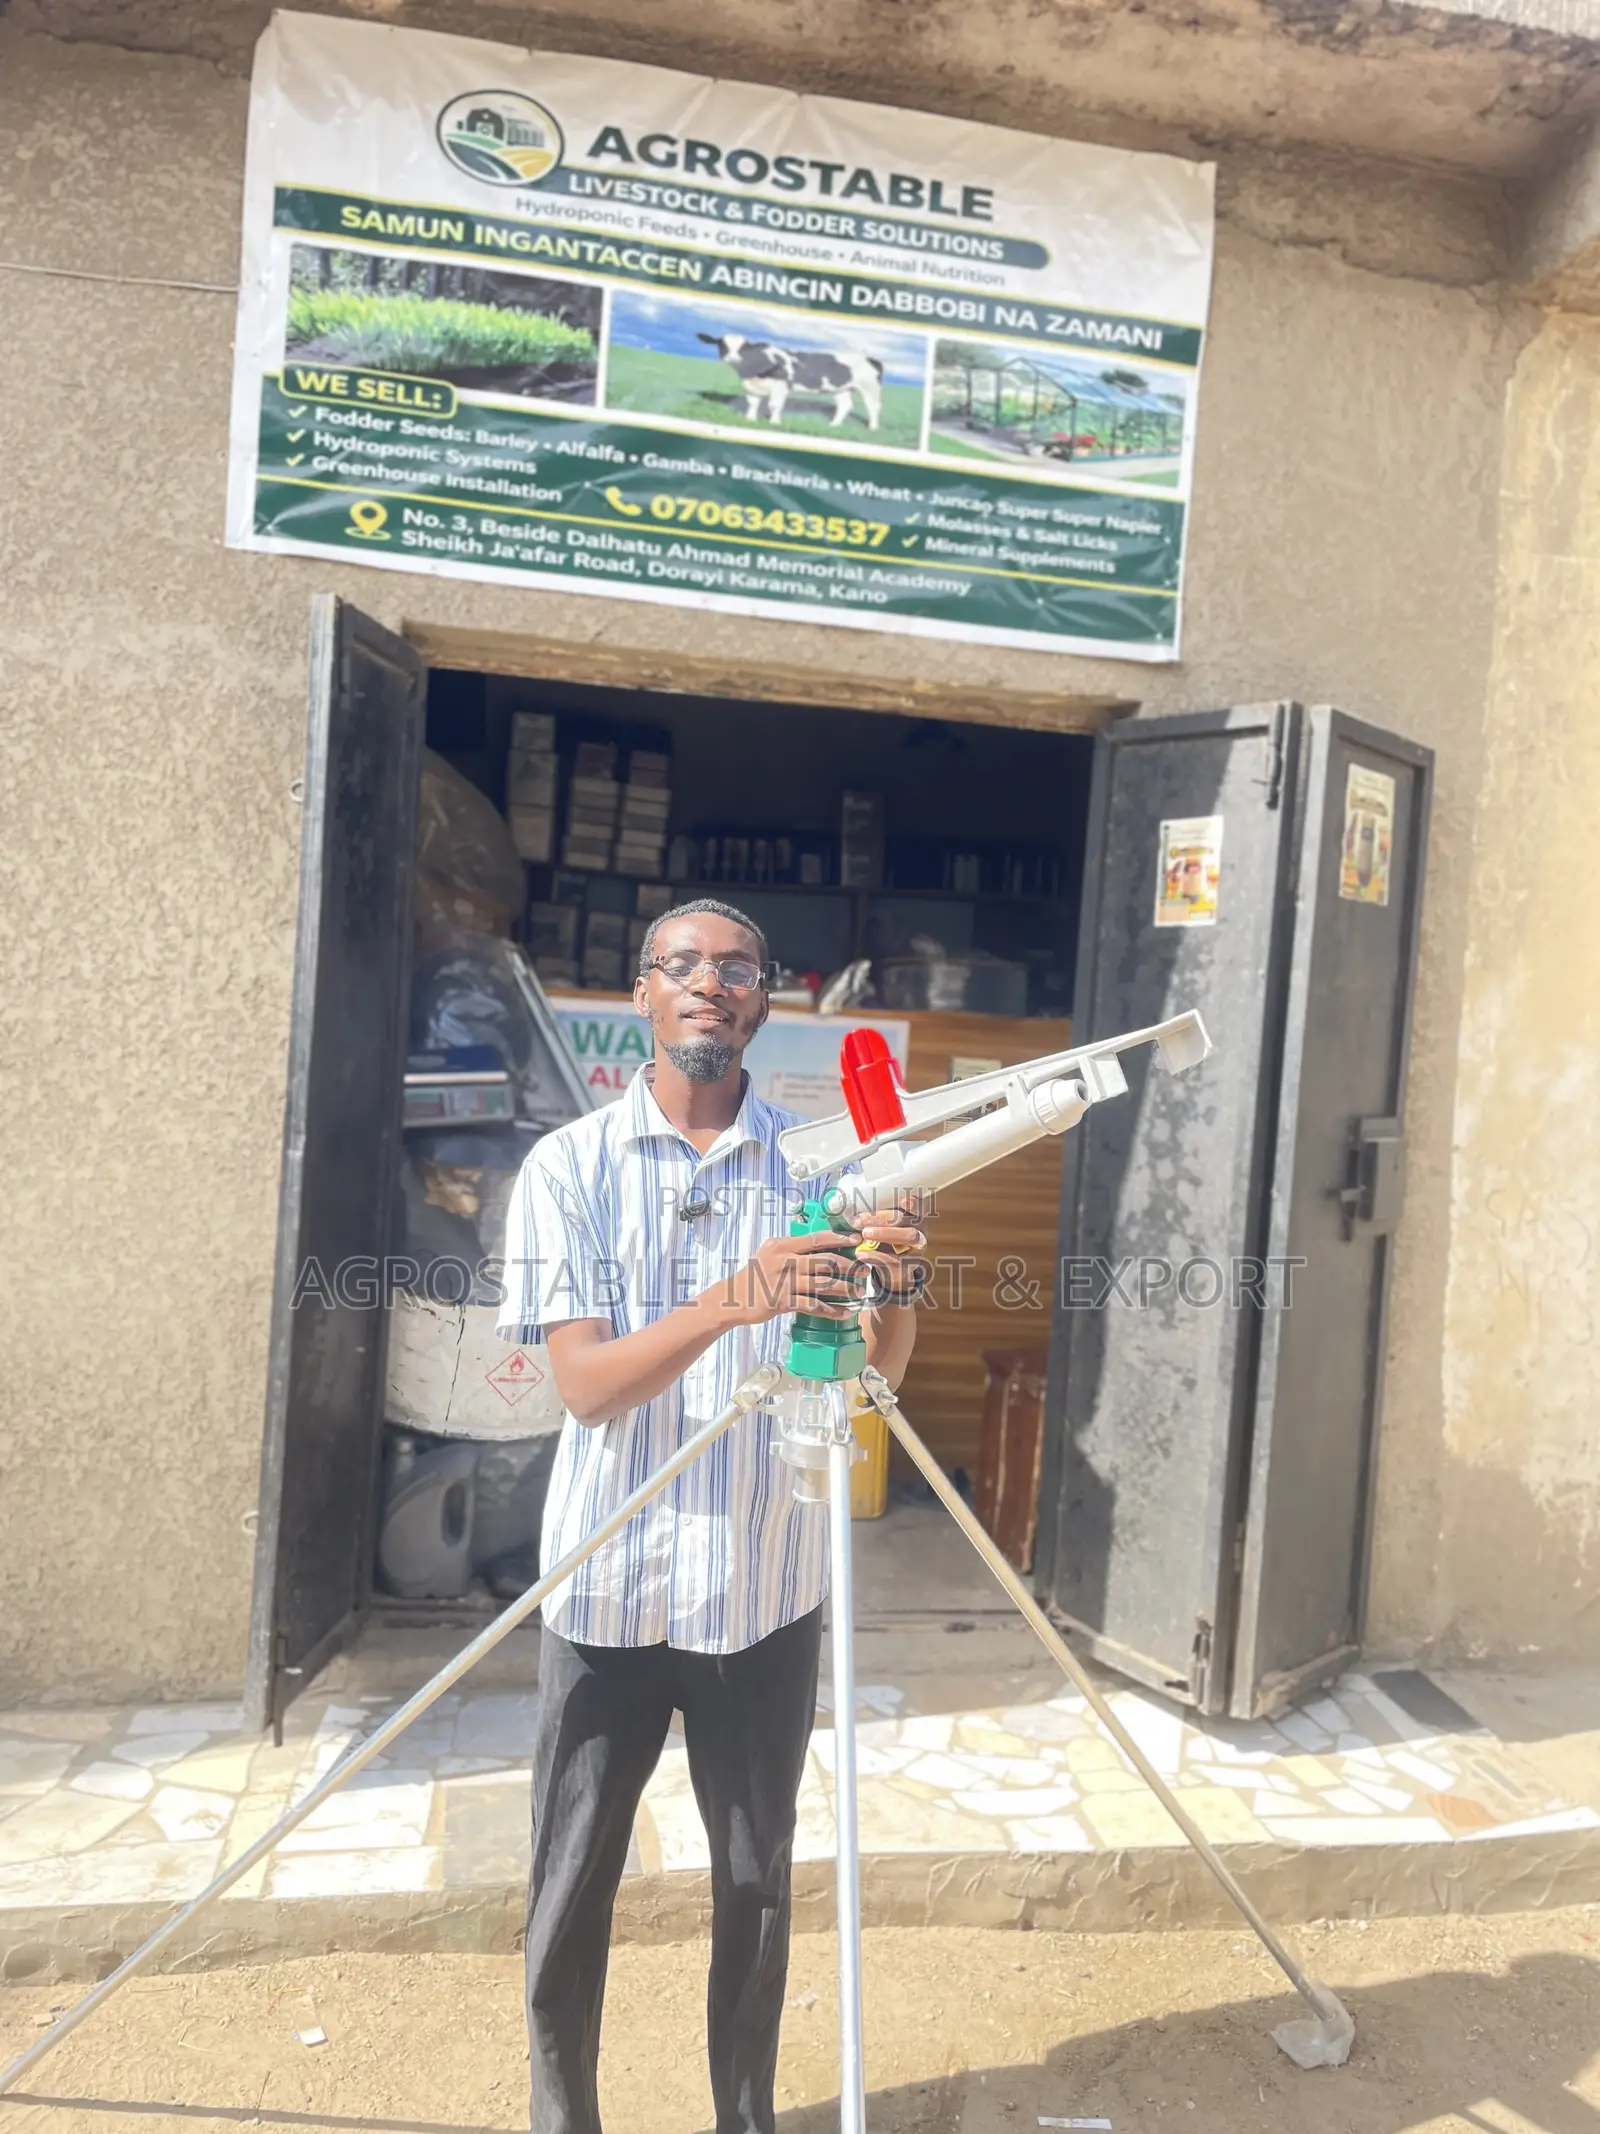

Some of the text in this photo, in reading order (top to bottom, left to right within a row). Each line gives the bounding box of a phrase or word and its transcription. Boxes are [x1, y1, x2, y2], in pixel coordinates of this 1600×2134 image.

[587, 125, 994, 221] AGROSTABLE
[515, 197, 1005, 286] Hydroponic Feeds Greenhouse Animal Nutrition
[569, 174, 1004, 260] LIVESTOCK & FODDER SOLUTIONS
[340, 205, 1163, 351] SAMUN INGANTACCEN ABINCIN DABBOBI NA ZAMANI
[295, 369, 442, 410] WE SELL:
[312, 455, 563, 503] Greenhouse Installation
[313, 431, 537, 475] Hydroponic Systems
[314, 406, 394, 432] Fodder
[400, 419, 472, 443] Seeds:
[475, 428, 538, 454] Barley
[556, 440, 626, 464] Alfalfa
[643, 452, 714, 476] Gamba
[731, 464, 830, 491] Brachiaria
[847, 479, 911, 502] Wheat
[997, 501, 1048, 522] Super
[1052, 508, 1103, 528] Super
[1105, 515, 1162, 536] Napier
[651, 494, 890, 547] 07063433537
[926, 513, 1118, 552] Molasses & Salt Licks
[401, 530, 888, 604] Sheikh Ja'afar Road, Dorayi Karama, Kano
[402, 507, 971, 597] No. 3, Beside Dalhatu Ahmad Memorial Academy
[925, 536, 1116, 574] Mineral Supplements
[571, 1020, 655, 1059] WA
[587, 1064, 640, 1090] AL
